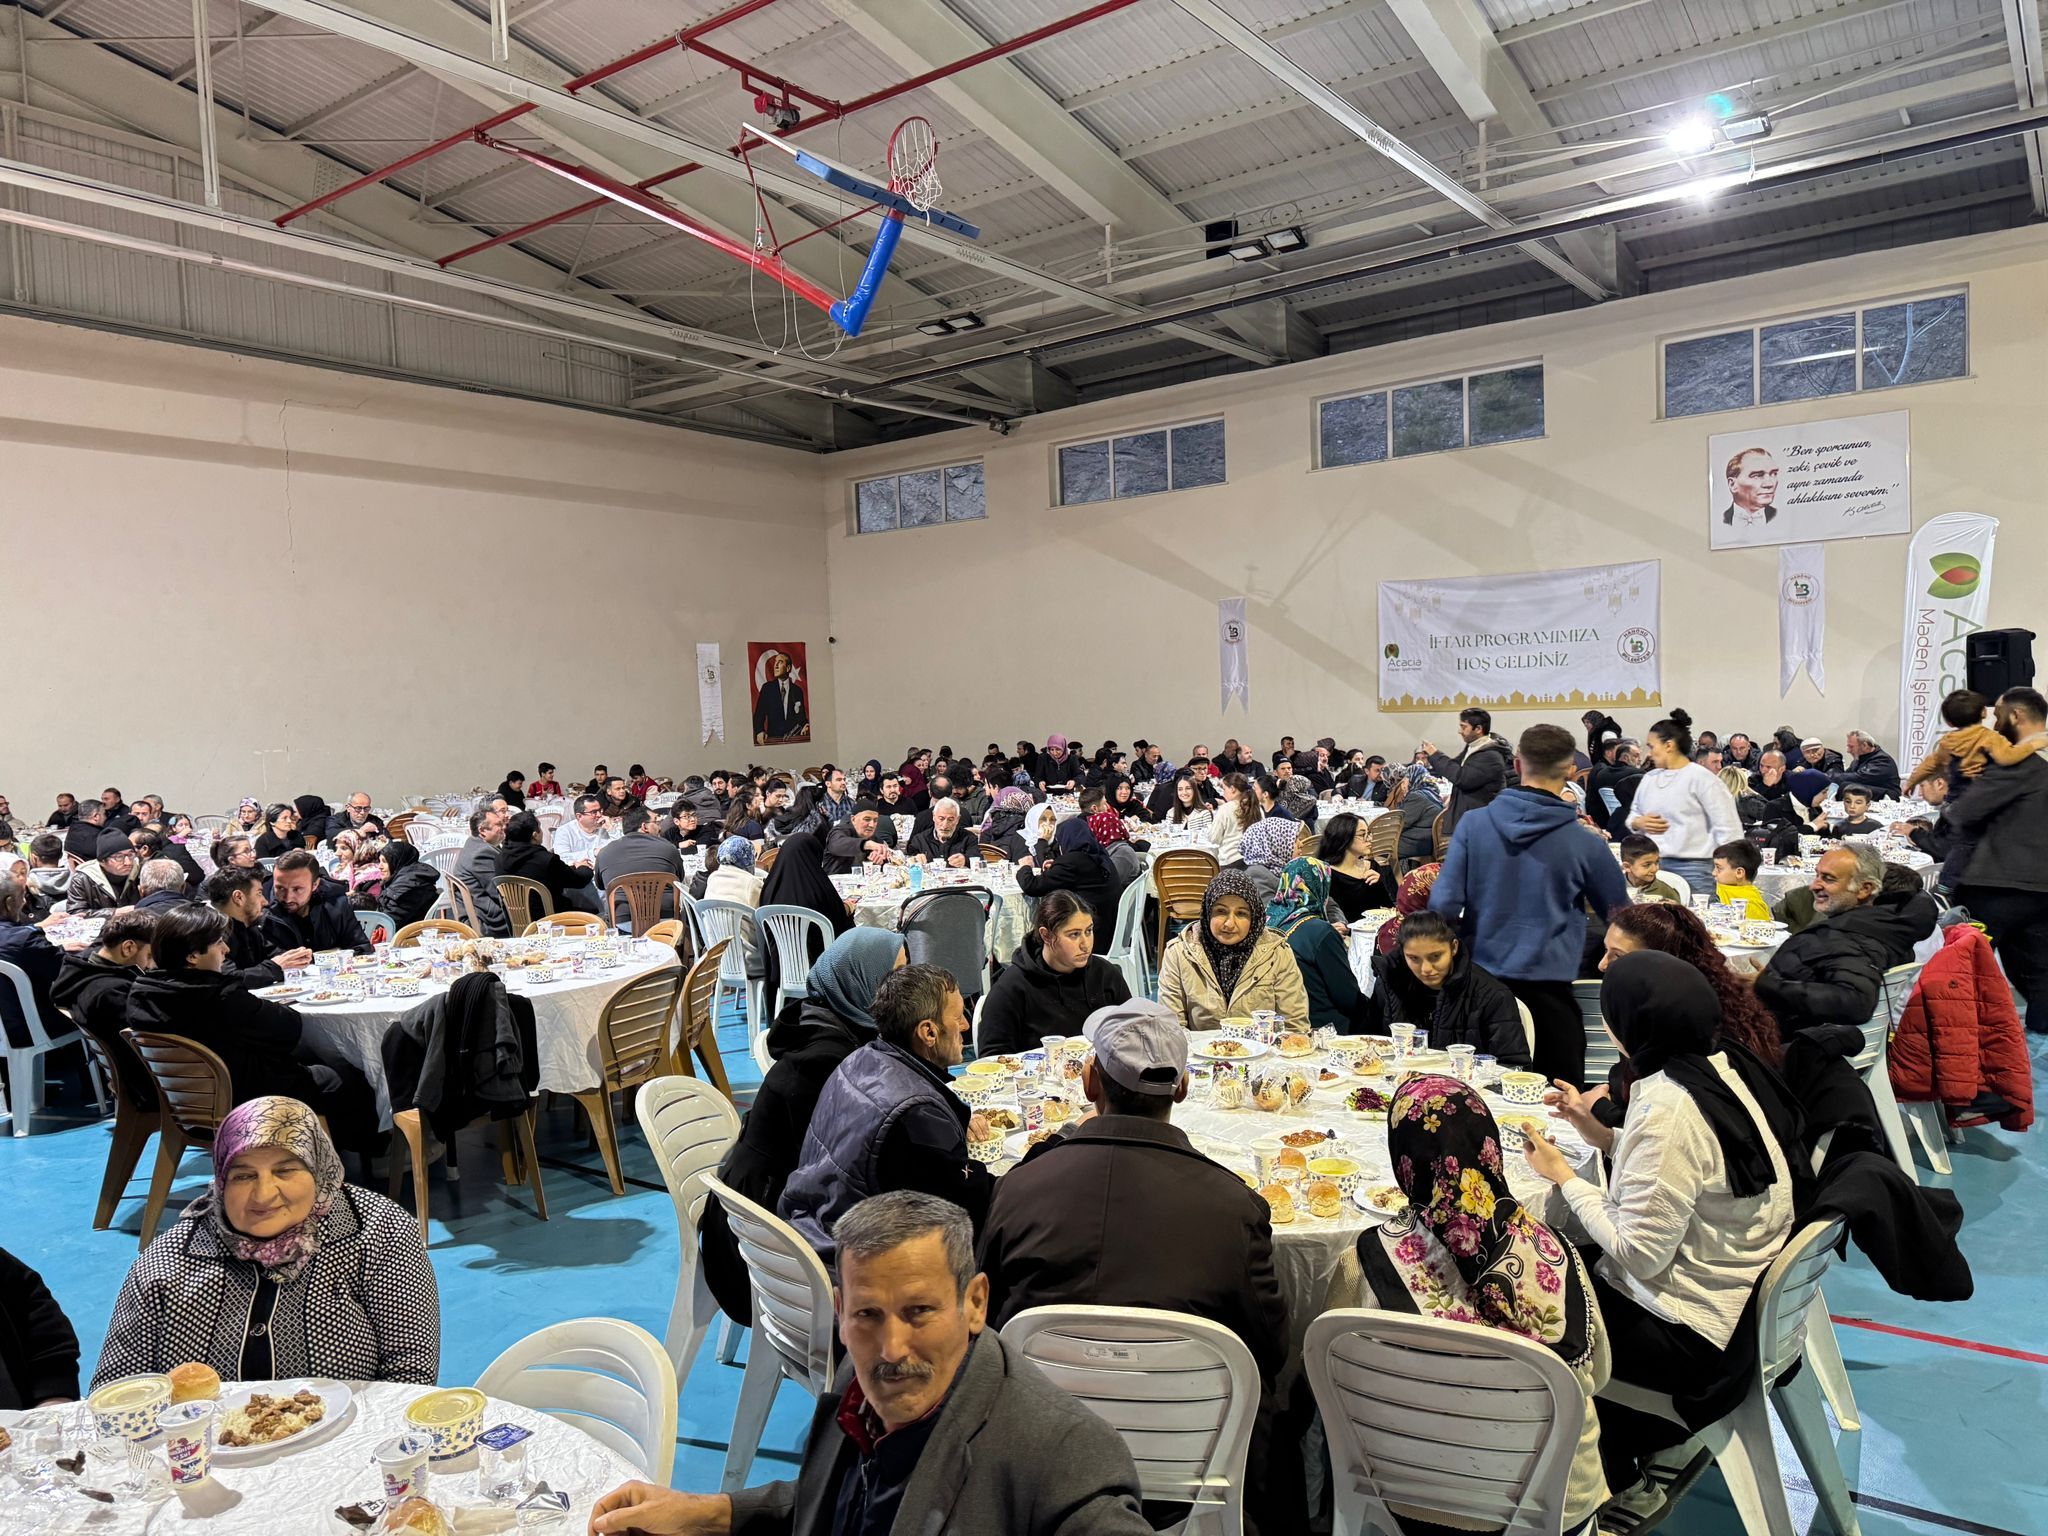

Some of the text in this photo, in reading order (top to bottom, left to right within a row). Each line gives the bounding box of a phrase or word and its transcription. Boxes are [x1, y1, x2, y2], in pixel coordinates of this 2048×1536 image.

[1813, 456, 1843, 473] çevik
[1844, 458, 1858, 466] ve
[1787, 470, 1864, 492] aynı zamanda
[1429, 628, 1600, 649] İFTAR PROGRAMIMIZA
[1915, 608, 1936, 671] Maden
[1387, 658, 1422, 667] Acacia
[1457, 651, 1569, 673] HOŞ GELDİNİZ
